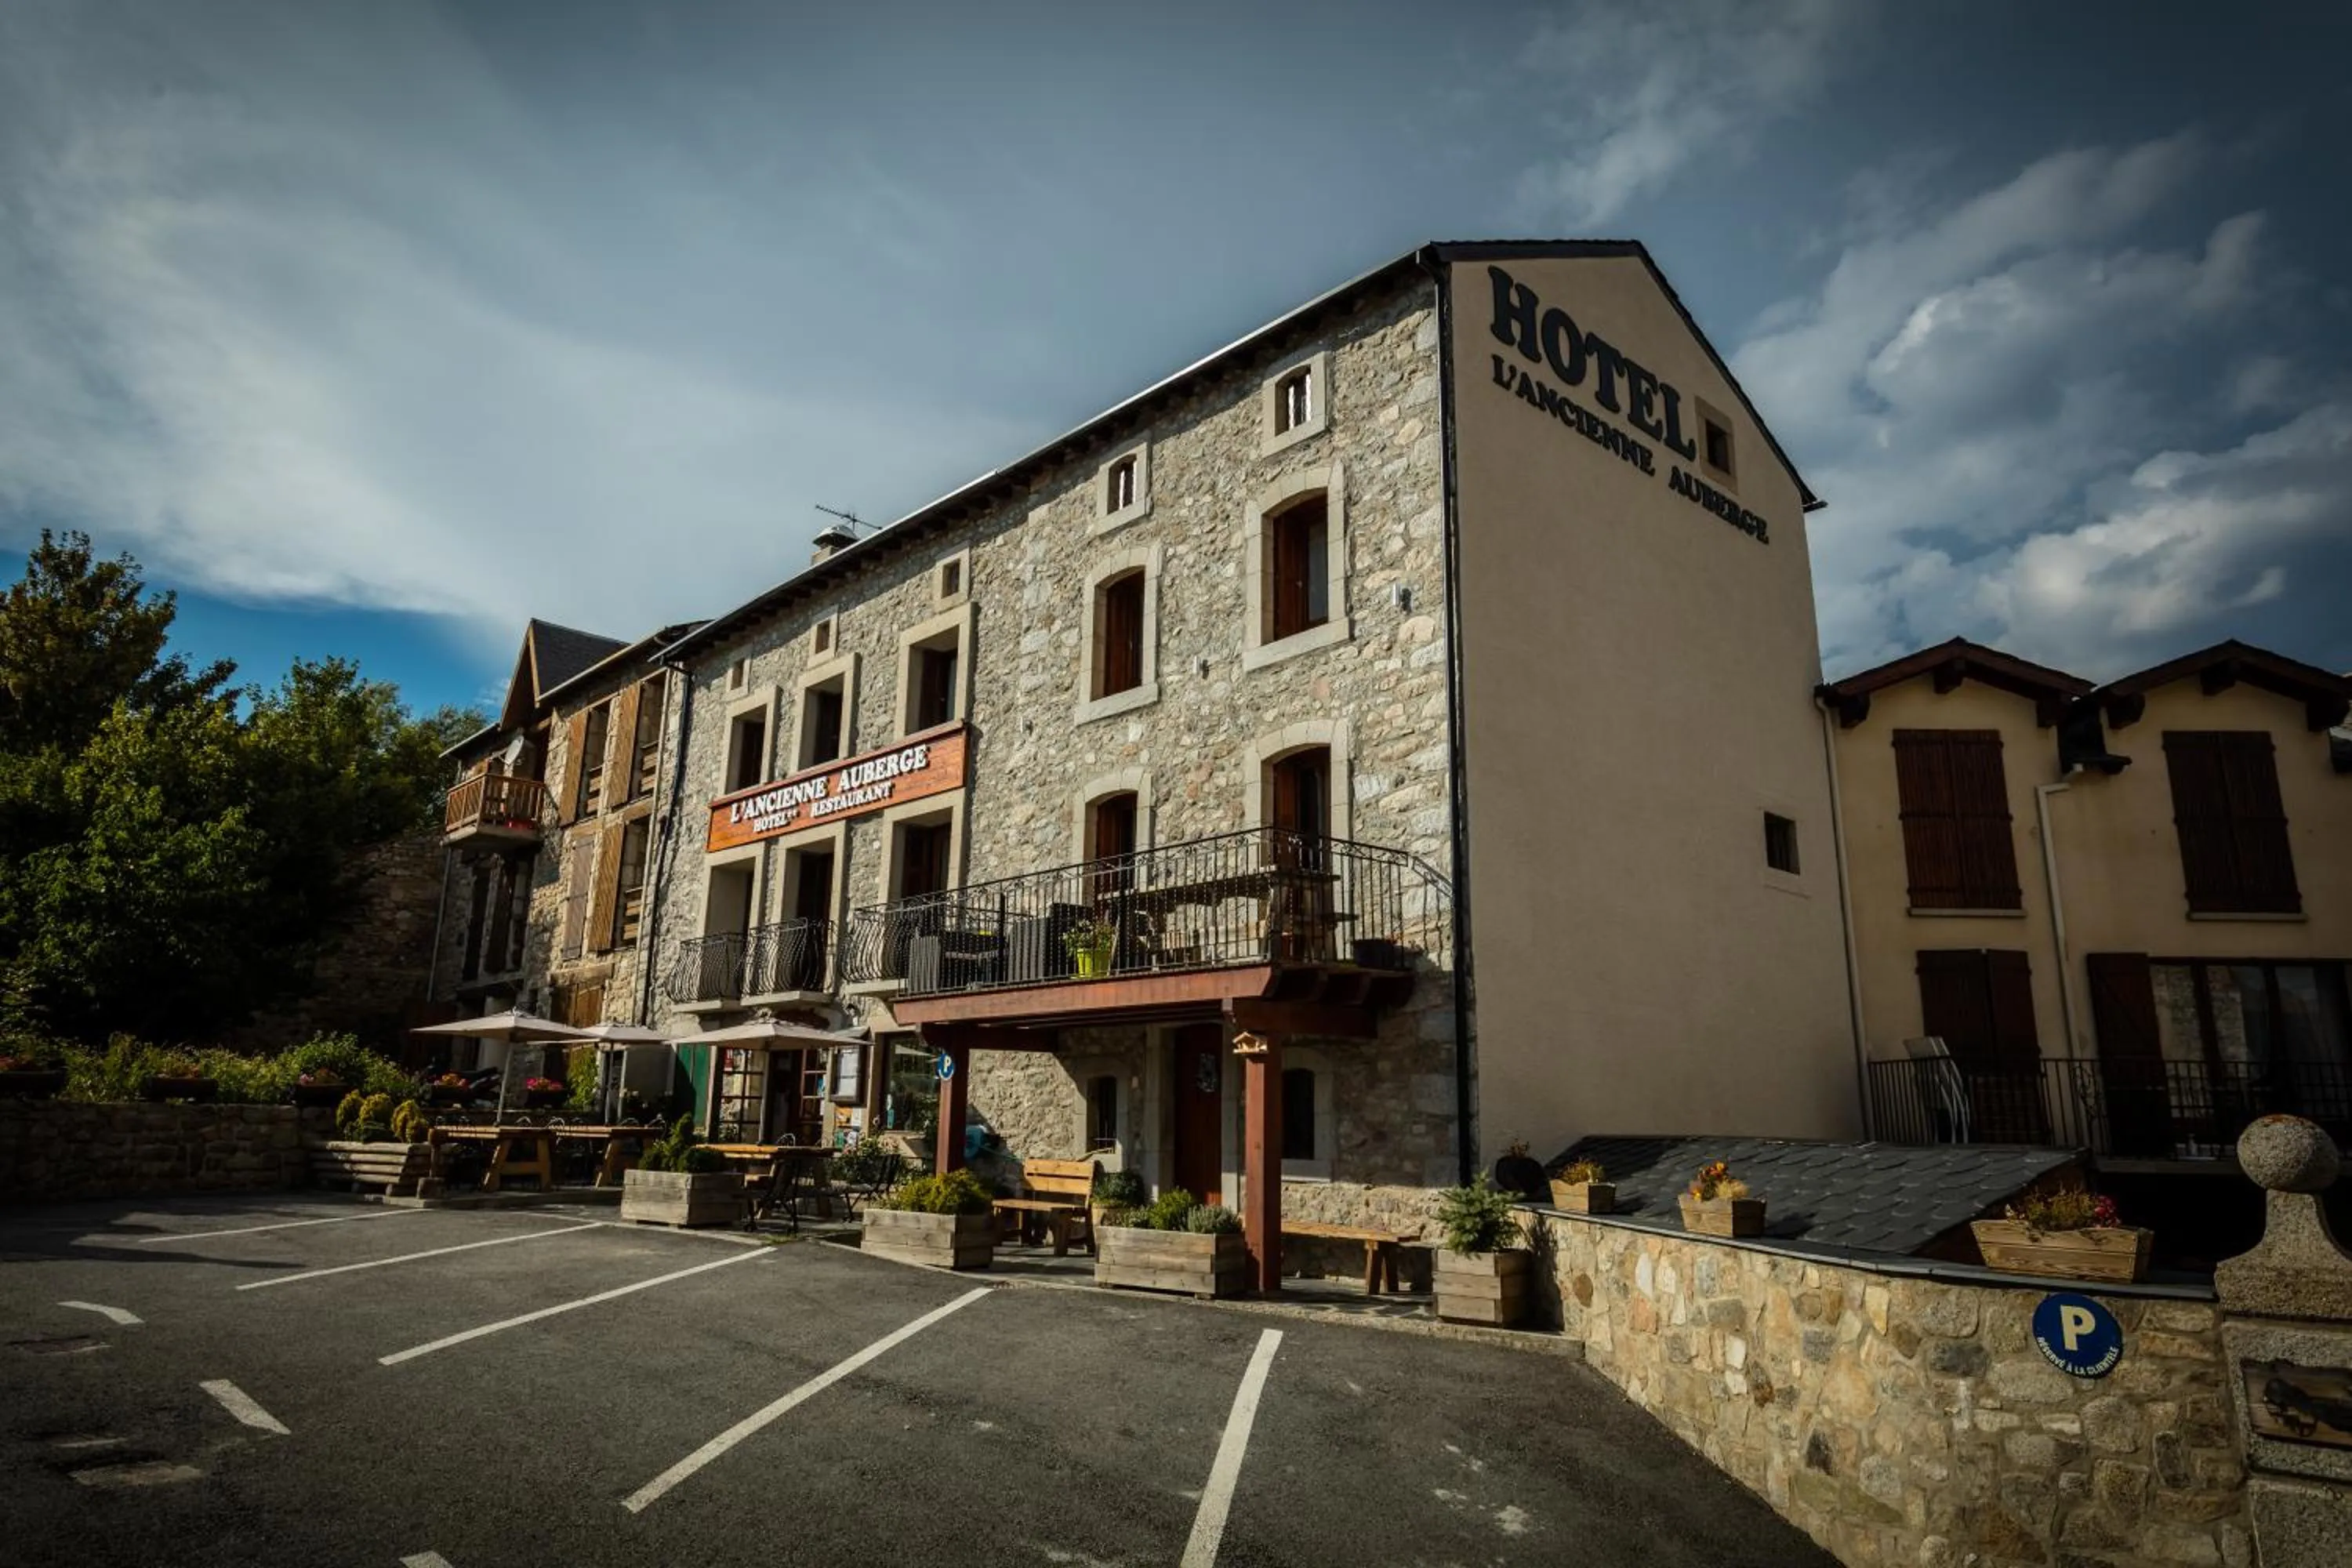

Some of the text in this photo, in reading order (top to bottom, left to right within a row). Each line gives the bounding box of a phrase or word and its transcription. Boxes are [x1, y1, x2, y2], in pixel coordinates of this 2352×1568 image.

[1487, 265, 1697, 462] HOTEL
[1491, 354, 1769, 544] L'ANCIENNE AUBERGE
[730, 744, 929, 823] L'ANCIENNE AUBERGE
[810, 782, 892, 818] RESTAURANT
[943, 1055, 952, 1073] P
[2060, 1305, 2096, 1351] P
